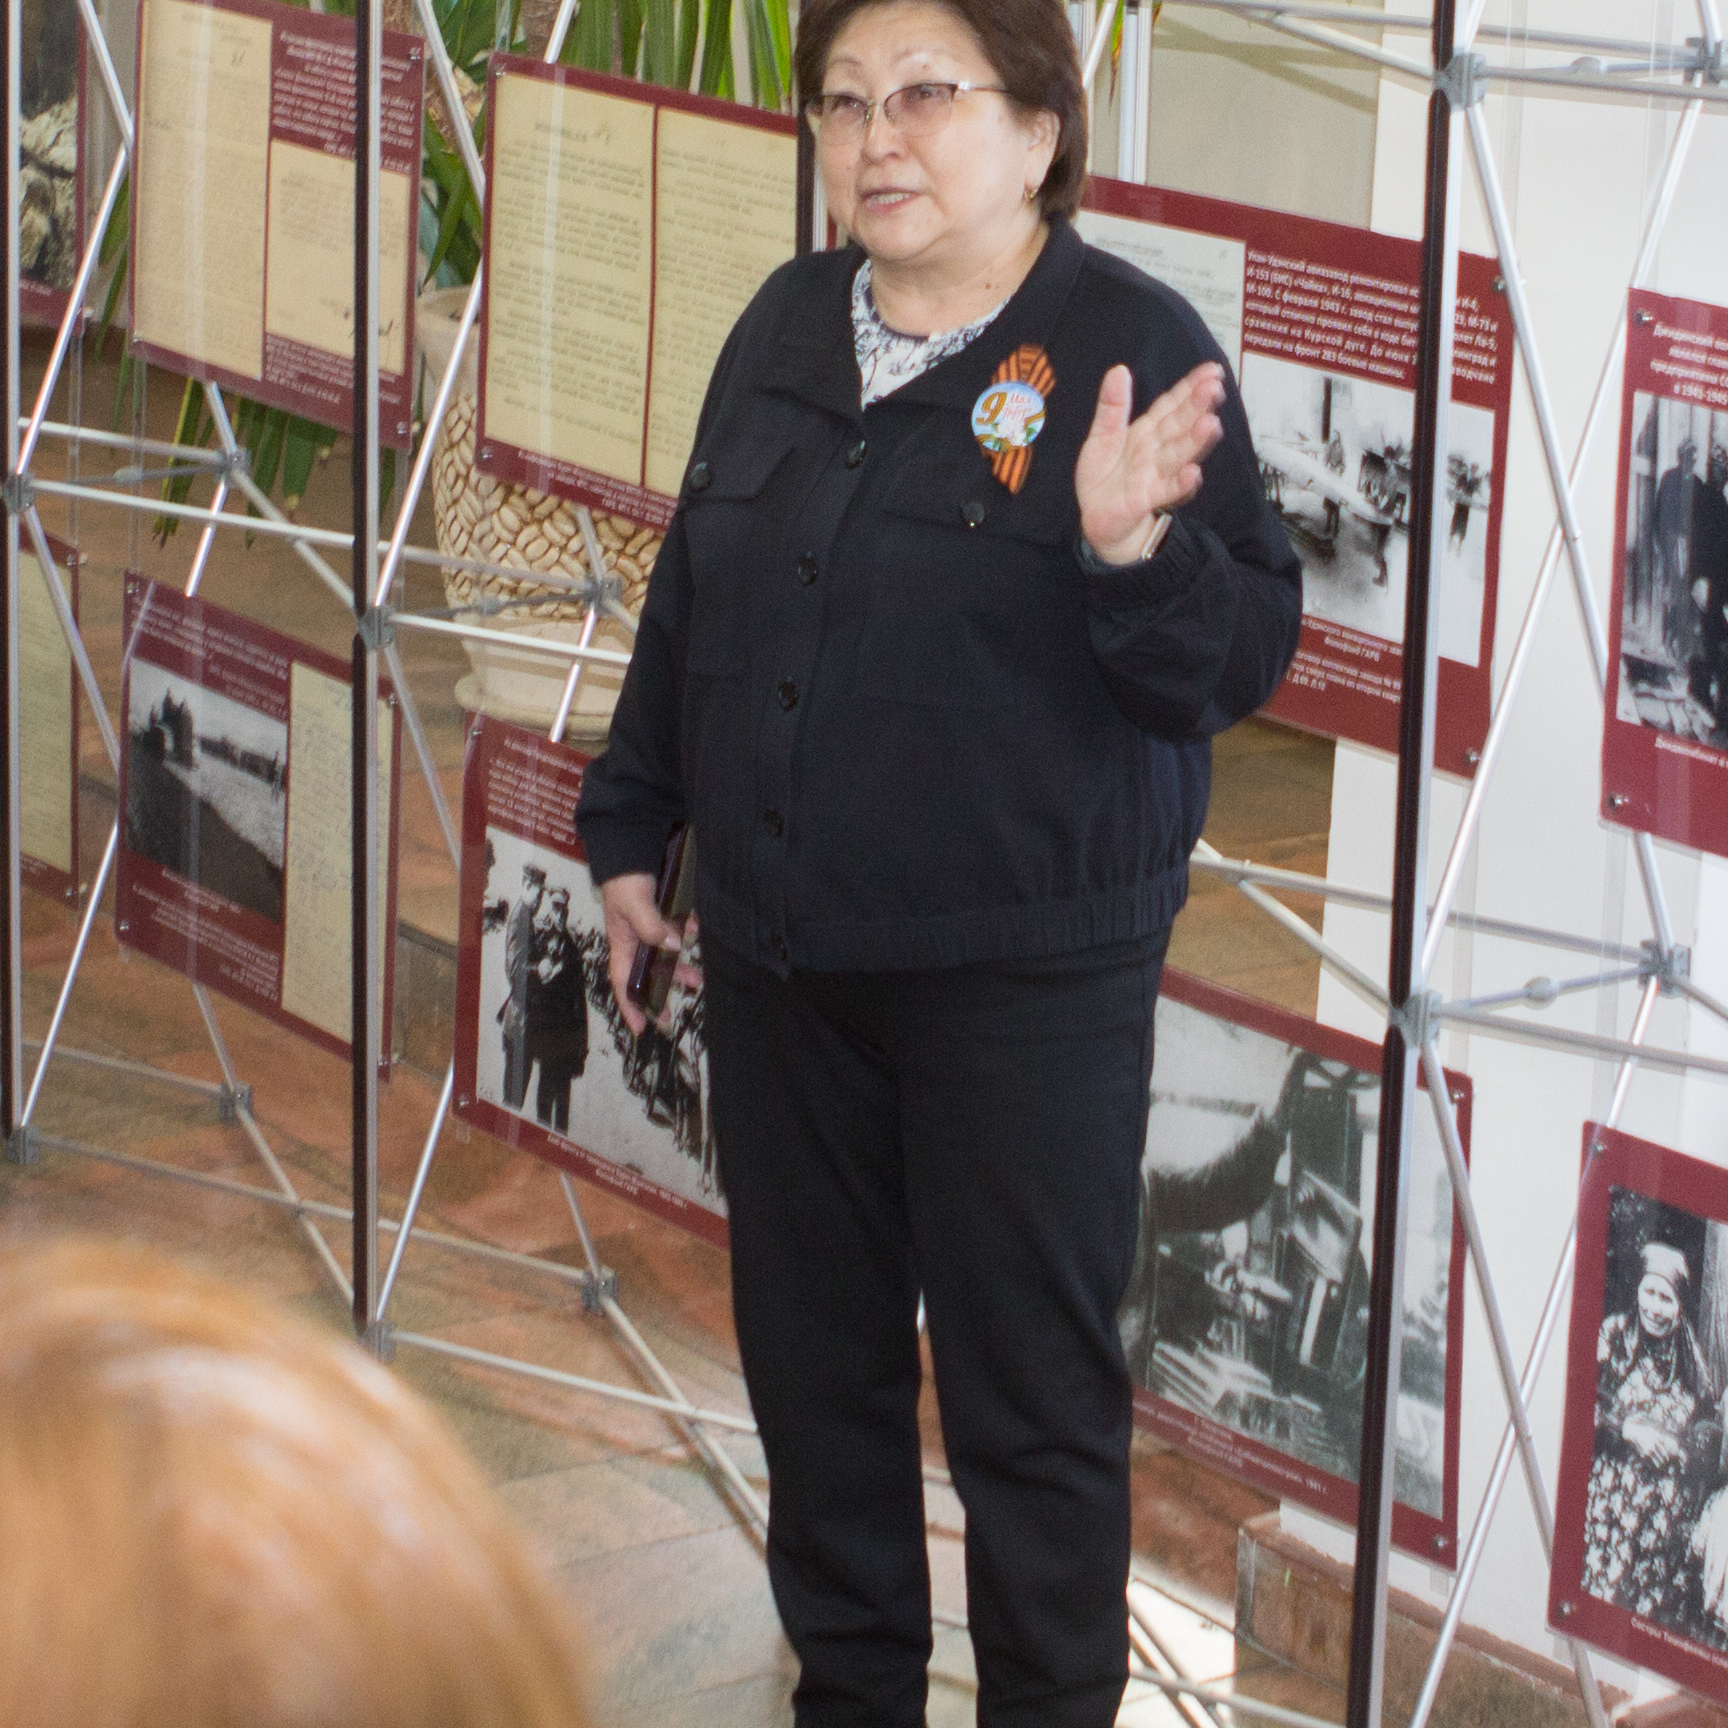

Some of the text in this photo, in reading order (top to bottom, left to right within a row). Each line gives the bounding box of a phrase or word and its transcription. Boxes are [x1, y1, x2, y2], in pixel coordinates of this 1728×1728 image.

[1304, 328, 1343, 346] Курской
[1293, 343, 1320, 358] фронт
[976, 391, 1007, 425] 9
